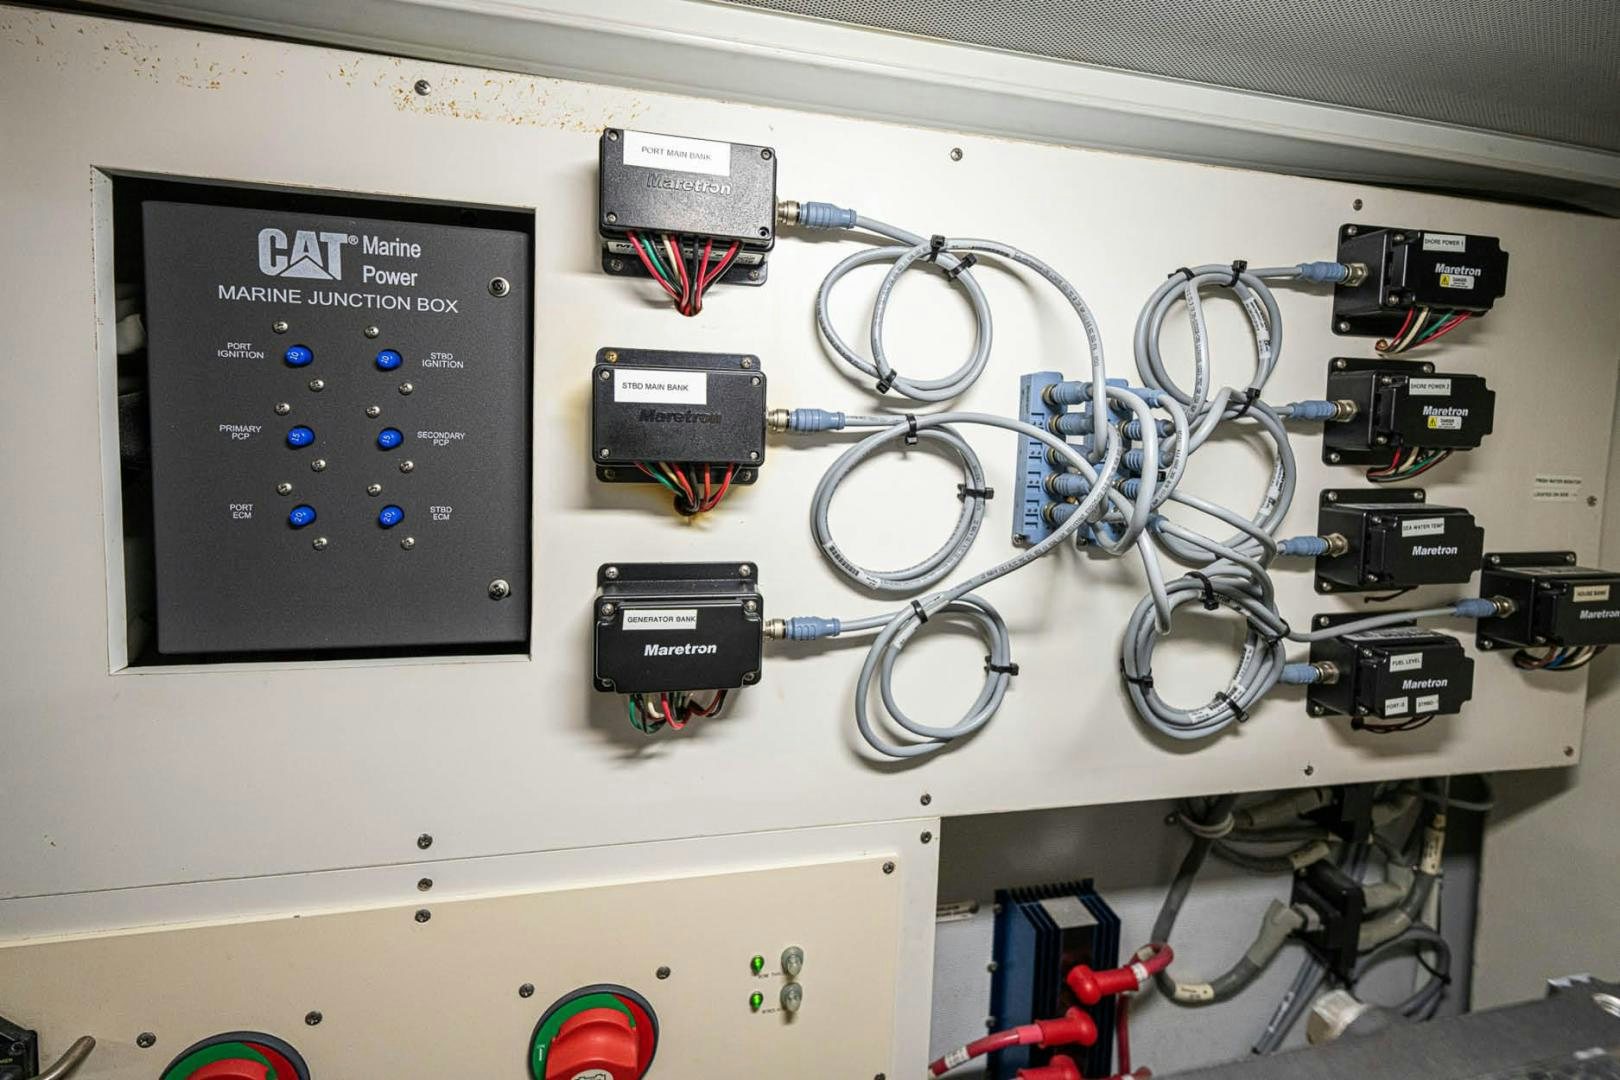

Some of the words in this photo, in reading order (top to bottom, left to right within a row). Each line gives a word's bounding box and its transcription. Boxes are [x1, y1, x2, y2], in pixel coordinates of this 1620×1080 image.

[641, 146, 664, 155] PORT
[667, 149, 688, 158] MAIN
[689, 152, 712, 160] BANK
[646, 172, 732, 195] Maretron
[362, 235, 422, 258] Marine
[1435, 262, 1482, 277] Maretron
[362, 265, 418, 287] Power
[218, 284, 302, 304] MARINE
[308, 290, 411, 311] JUNCTION
[417, 298, 459, 314] BOX
[227, 342, 252, 351] PORT
[217, 349, 265, 360] IGNITION
[430, 351, 454, 361] STBD
[422, 359, 464, 369] IGNITION
[621, 382, 643, 391] STBD
[644, 383, 665, 391] MAIN
[666, 383, 689, 392] BANK
[639, 407, 722, 424] Maretron
[1422, 405, 1469, 417] Maretron
[219, 424, 262, 433] PRIMARY
[231, 432, 250, 440] PCP
[416, 431, 466, 440] SECONDARY
[432, 438, 450, 447] PCP
[229, 503, 254, 511] PORT
[430, 506, 453, 514] STBD
[232, 510, 252, 519] ECM
[432, 513, 450, 521] ECM
[1411, 545, 1459, 556] Maretron
[627, 616, 674, 624] GENERATOR
[675, 615, 697, 623] BANK
[643, 643, 718, 657] Maretron
[1401, 678, 1449, 690] Maretron
